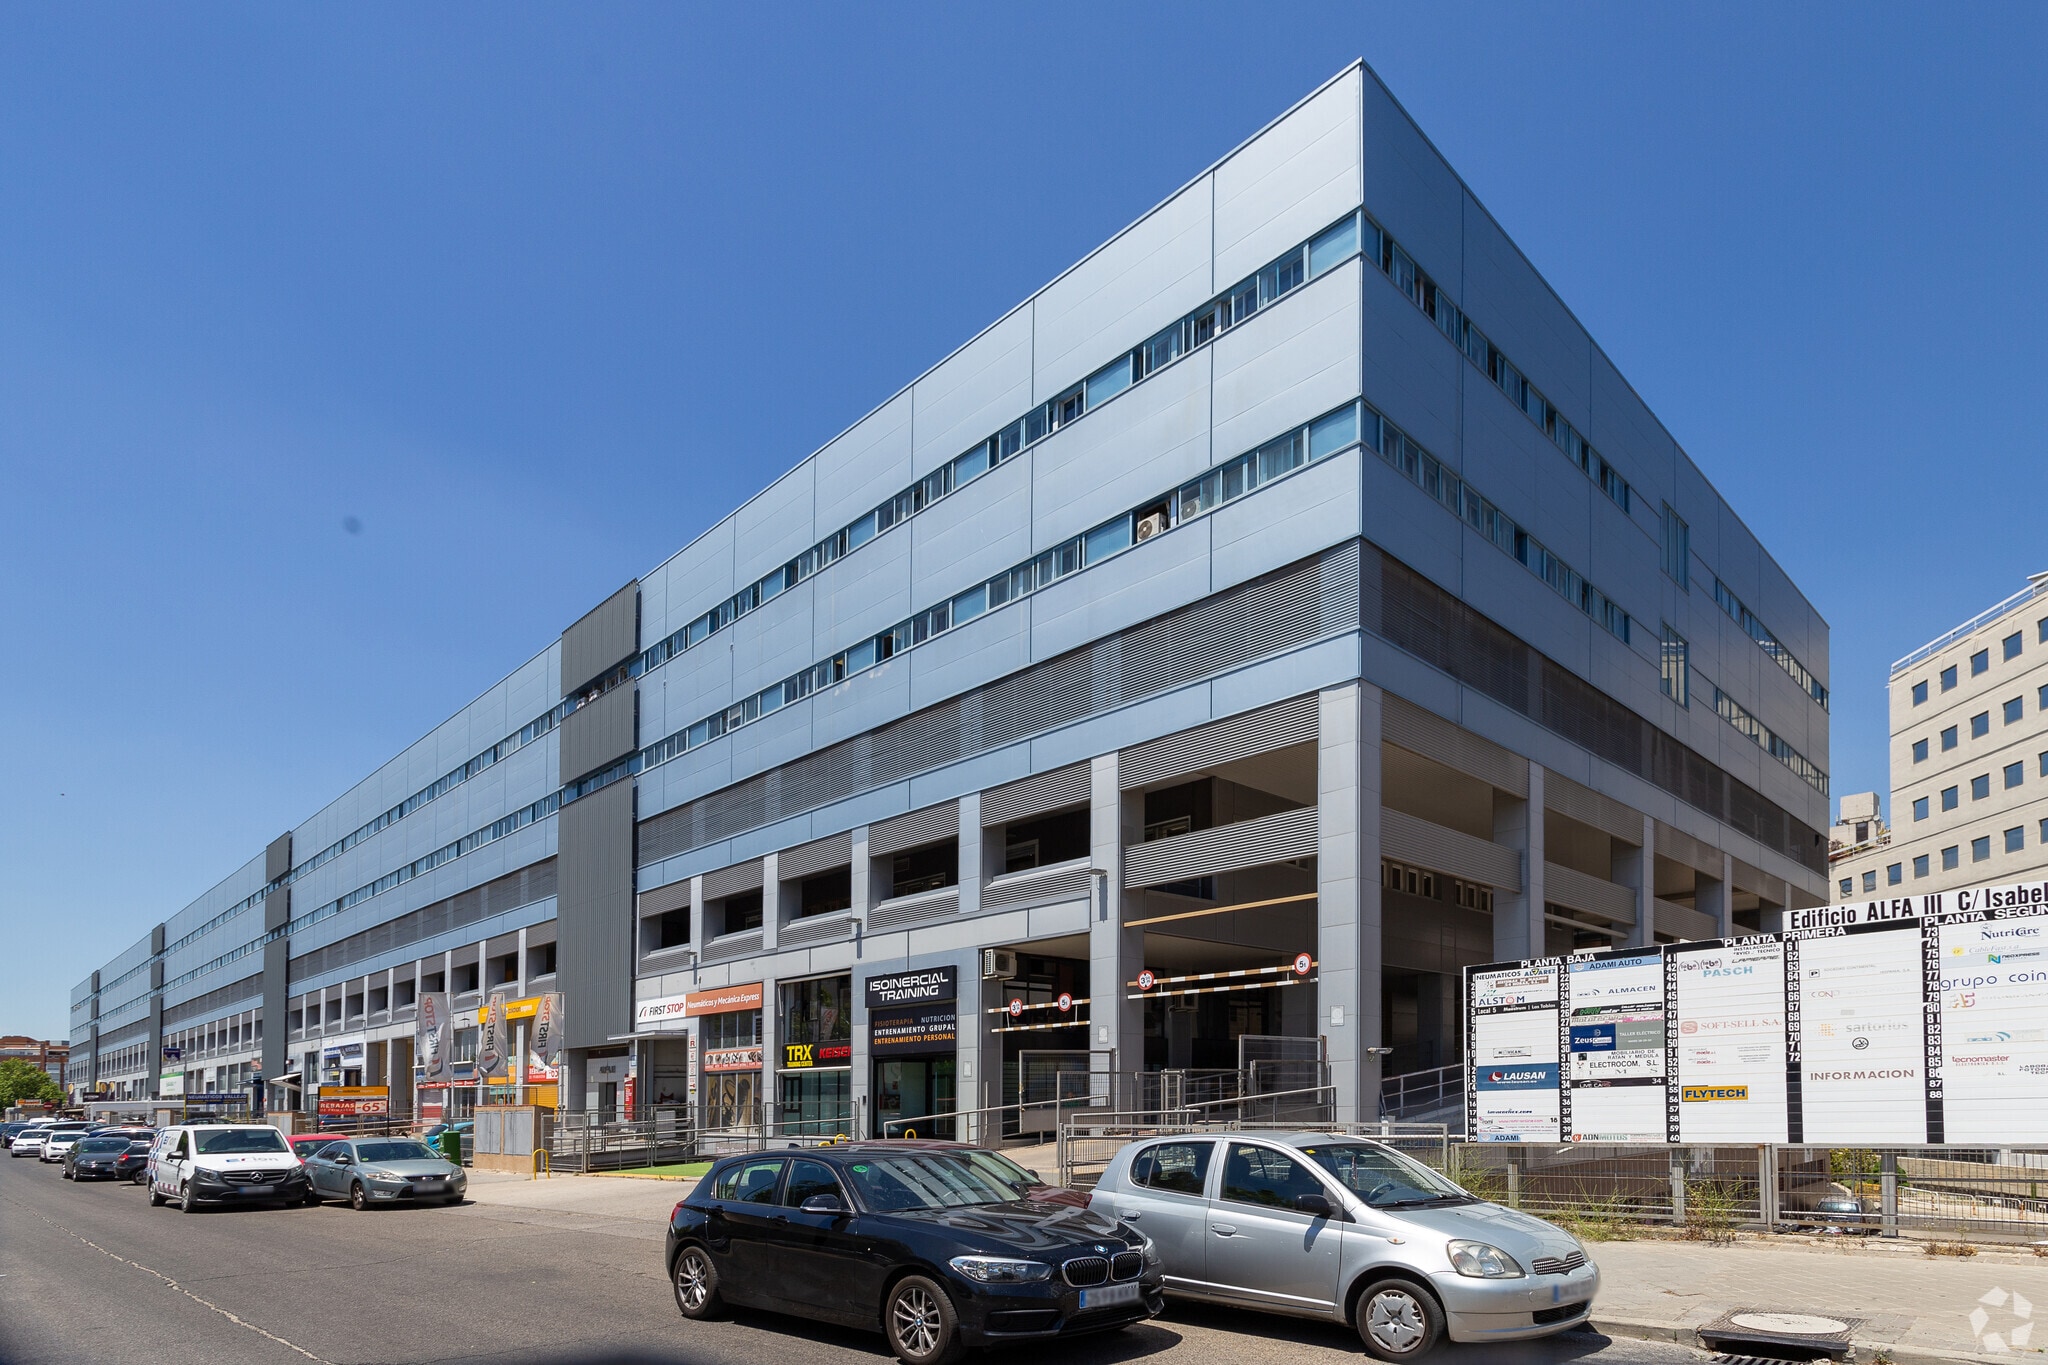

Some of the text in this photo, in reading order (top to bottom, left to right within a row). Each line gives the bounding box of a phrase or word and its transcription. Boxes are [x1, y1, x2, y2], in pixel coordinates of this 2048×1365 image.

[1791, 882, 2048, 929] Edificio ALFA III C/ Isabel
[1924, 911, 1987, 926] PLANTA
[1724, 926, 1846, 948] PLANTA PRIMERA
[1925, 928, 1938, 937] 73
[1787, 942, 1799, 950] 61
[1925, 939, 1938, 948] 74
[1666, 954, 1676, 962] 41
[1787, 952, 1799, 960] 62
[1925, 949, 1939, 958] 75
[1520, 954, 1596, 968] PLANTA BAJA
[1589, 958, 1642, 970] ADAMI AUTO
[1926, 960, 1939, 969] 76
[1787, 962, 1799, 970] 63
[1477, 971, 1521, 981] NEUMATICOS
[1703, 966, 1753, 977] PASCH
[1787, 972, 1799, 980] 64
[1926, 971, 1939, 980] 77
[870, 971, 949, 992] ISOINERCIAL
[1667, 973, 1677, 981] 43
[1788, 982, 1799, 990] 65
[1926, 982, 1939, 991] 78
[1941, 975, 1998, 991] grupo
[879, 984, 939, 1002] TRAINING
[1608, 985, 1656, 994] ALMACEN
[1479, 995, 1525, 1006] ALSTOM
[1667, 992, 1677, 1000] 45
[1788, 992, 1799, 1001] 66
[1927, 993, 1940, 1002] 79
[649, 1004, 666, 1017] FIRST
[666, 1002, 684, 1014] STOP
[740, 993, 760, 1004] Express
[1788, 1002, 1799, 1011] 67
[1927, 1003, 1940, 1012] 80
[1667, 1011, 1677, 1019] 47
[1788, 1012, 1799, 1021] 68
[1927, 1014, 1940, 1023] 81
[874, 1013, 956, 1028] FISIOTERAPIA NUTRICION
[1700, 1019, 1782, 1030] SOFT-SELL S.A.
[874, 1022, 956, 1037] ENTRENAMIENTO GRUPAL
[1788, 1022, 1800, 1031] 69
[1928, 1025, 1941, 1034] 82
[874, 1032, 956, 1045] ENTRENAMIENTO PERSONAL
[1668, 1030, 1678, 1038] 49
[1789, 1033, 1800, 1041] 70
[1928, 1036, 1941, 1045] 83
[1789, 1043, 1800, 1051] 71
[1928, 1047, 1941, 1056] 84
[786, 1044, 814, 1061] TRX
[1668, 1049, 1678, 1057] 51
[1789, 1053, 1800, 1061] 72
[1668, 1058, 1678, 1066] 52
[1929, 1058, 1941, 1067] 85
[1952, 1055, 2010, 1063] tecnomaster
[1503, 1071, 1546, 1080] LAUSAN
[1668, 1068, 1678, 1076] 53
[1810, 1069, 1915, 1081] INFORMACION
[1668, 1077, 1679, 1085] 54
[1929, 1079, 1942, 1088] 87
[1668, 1086, 1679, 1094] 55
[1685, 1089, 1746, 1098] FLYTECH
[1930, 1090, 1942, 1099] 88
[1668, 1096, 1679, 1104] 56
[1668, 1105, 1679, 1113] 57
[1668, 1115, 1679, 1123] 58
[1668, 1124, 1680, 1132] 59
[1668, 1134, 1680, 1142] 60
